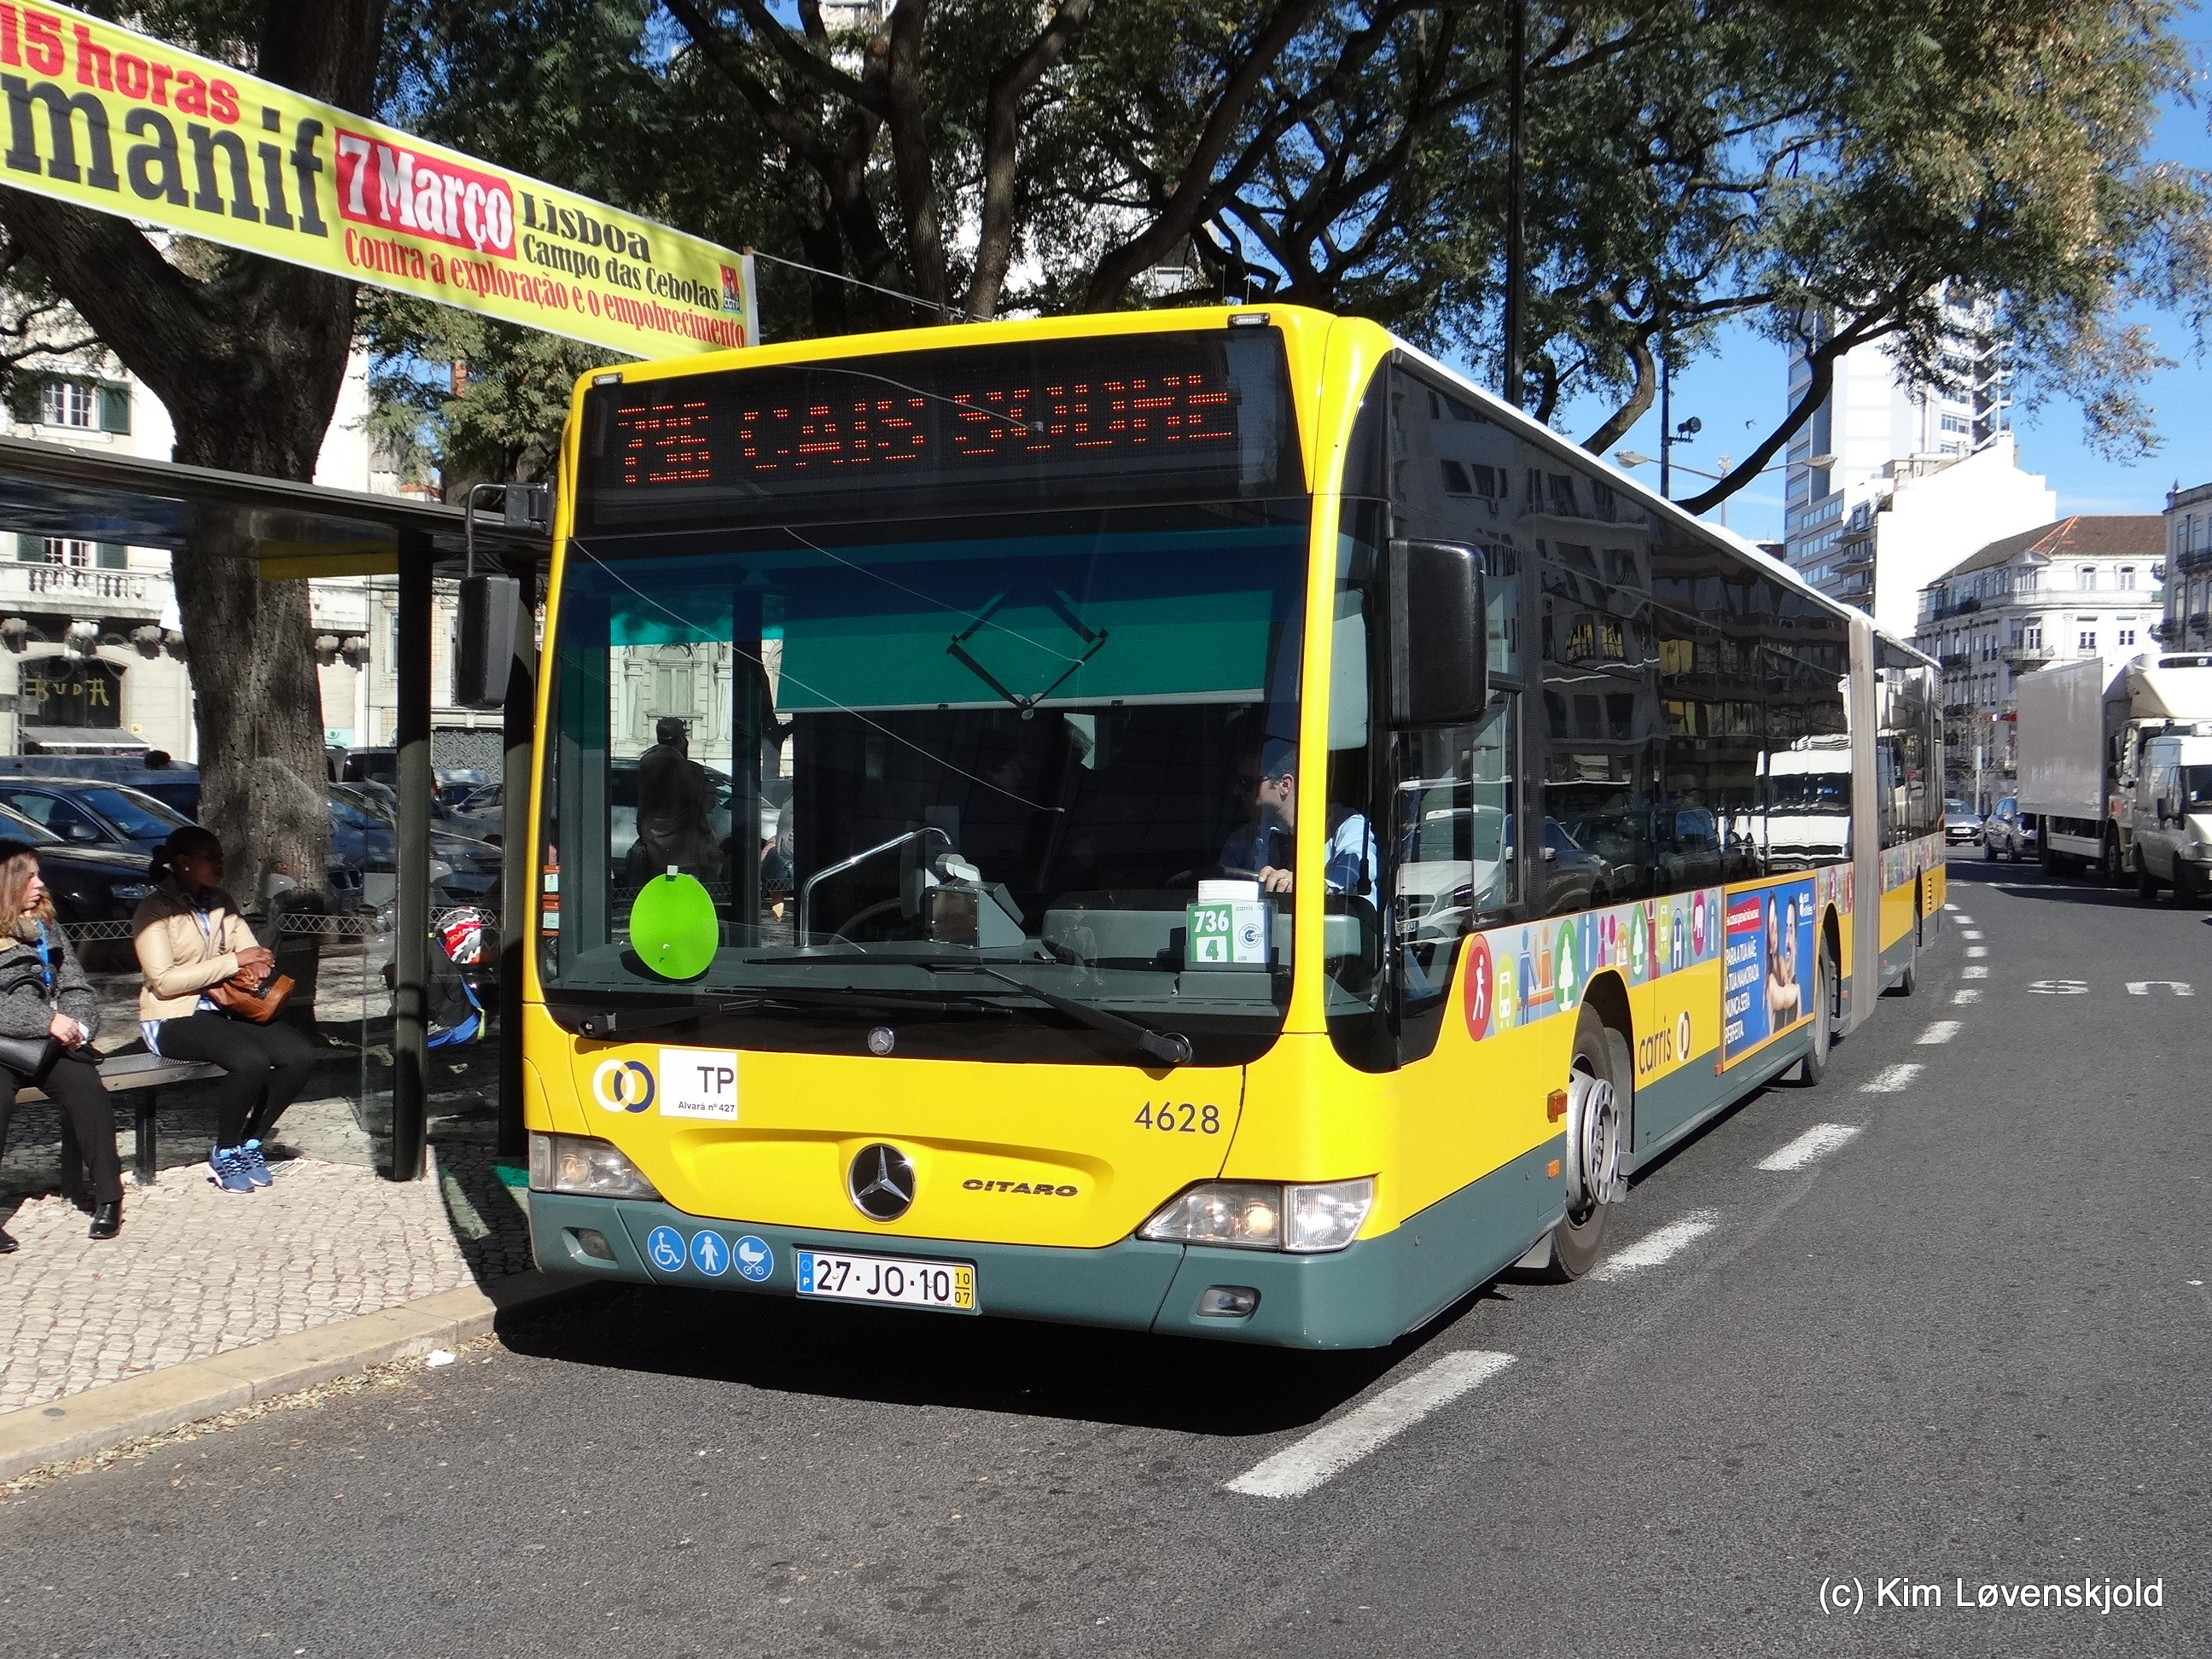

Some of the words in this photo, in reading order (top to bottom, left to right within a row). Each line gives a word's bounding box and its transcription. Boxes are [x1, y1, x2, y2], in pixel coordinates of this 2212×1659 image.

[0, 2, 65, 77] 15
[73, 22, 241, 125] horas
[0, 72, 329, 238] manif
[339, 134, 371, 216] 7
[376, 144, 513, 253] Março
[518, 190, 652, 264] Lisboa
[345, 227, 427, 281] Contra
[430, 253, 446, 285] a
[451, 257, 569, 310] exploração
[572, 286, 585, 314] e
[587, 289, 601, 317] o
[603, 293, 745, 348] empobrecimento
[522, 233, 601, 279] Campo
[605, 257, 641, 291] das
[645, 267, 719, 311] Cebolas
[724, 297, 740, 311] CGTP
[740, 398, 924, 469] CAIS
[1194, 910, 1229, 933] 736
[1205, 940, 1219, 960] 4
[1639, 1015, 1672, 1075] carris
[696, 1066, 735, 1094] TP
[678, 1101, 706, 1111] Alvará
[719, 1103, 736, 1112] 427
[1133, 1100, 1221, 1135] 4628
[962, 1179, 1080, 1197] CITARO
[803, 1277, 810, 1286] P
[955, 1272, 971, 1285] 10
[954, 1291, 970, 1305] 07
